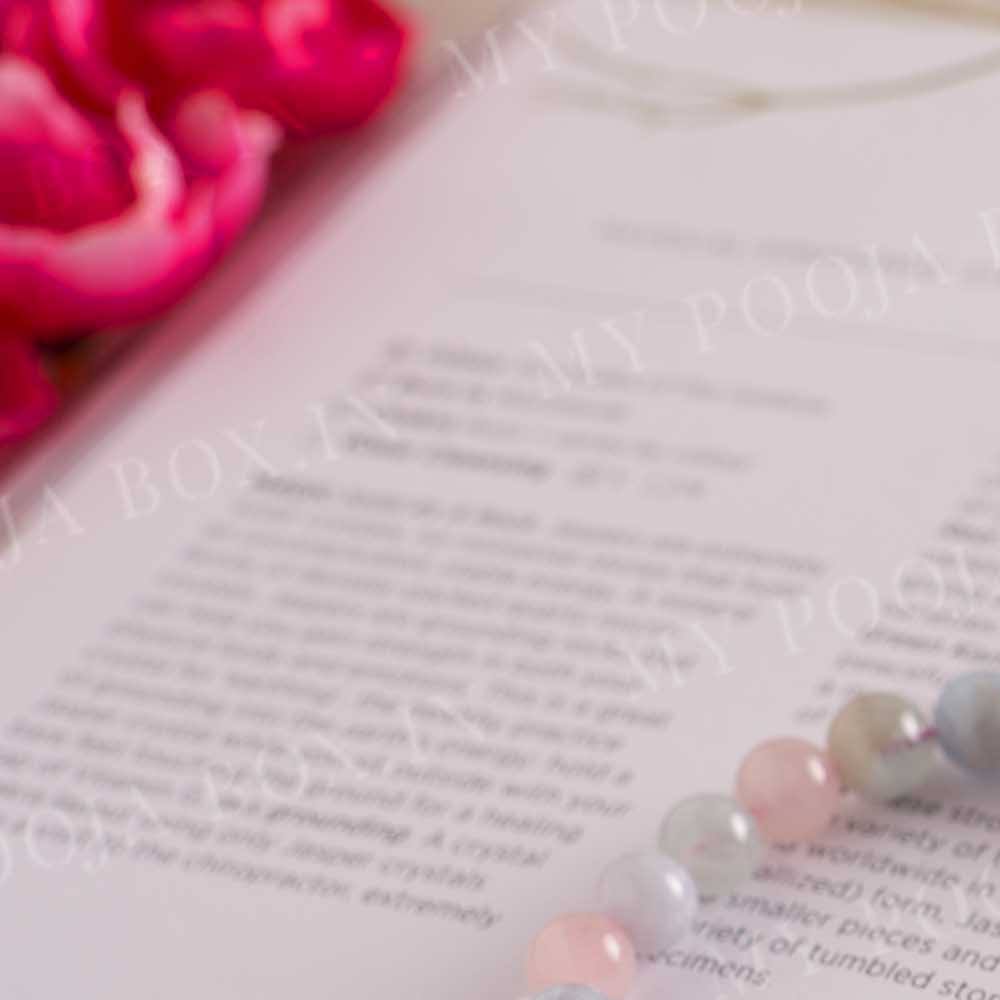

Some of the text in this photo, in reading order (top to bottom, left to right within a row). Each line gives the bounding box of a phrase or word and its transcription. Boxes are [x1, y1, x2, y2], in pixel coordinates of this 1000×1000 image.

[950, 840, 991, 862] of
[871, 885, 946, 925] form,
[966, 880, 997, 899] in
[726, 892, 831, 928] smaller
[836, 918, 938, 955] pieces
[768, 935, 808, 957] of
[808, 944, 938, 992] tumbled
